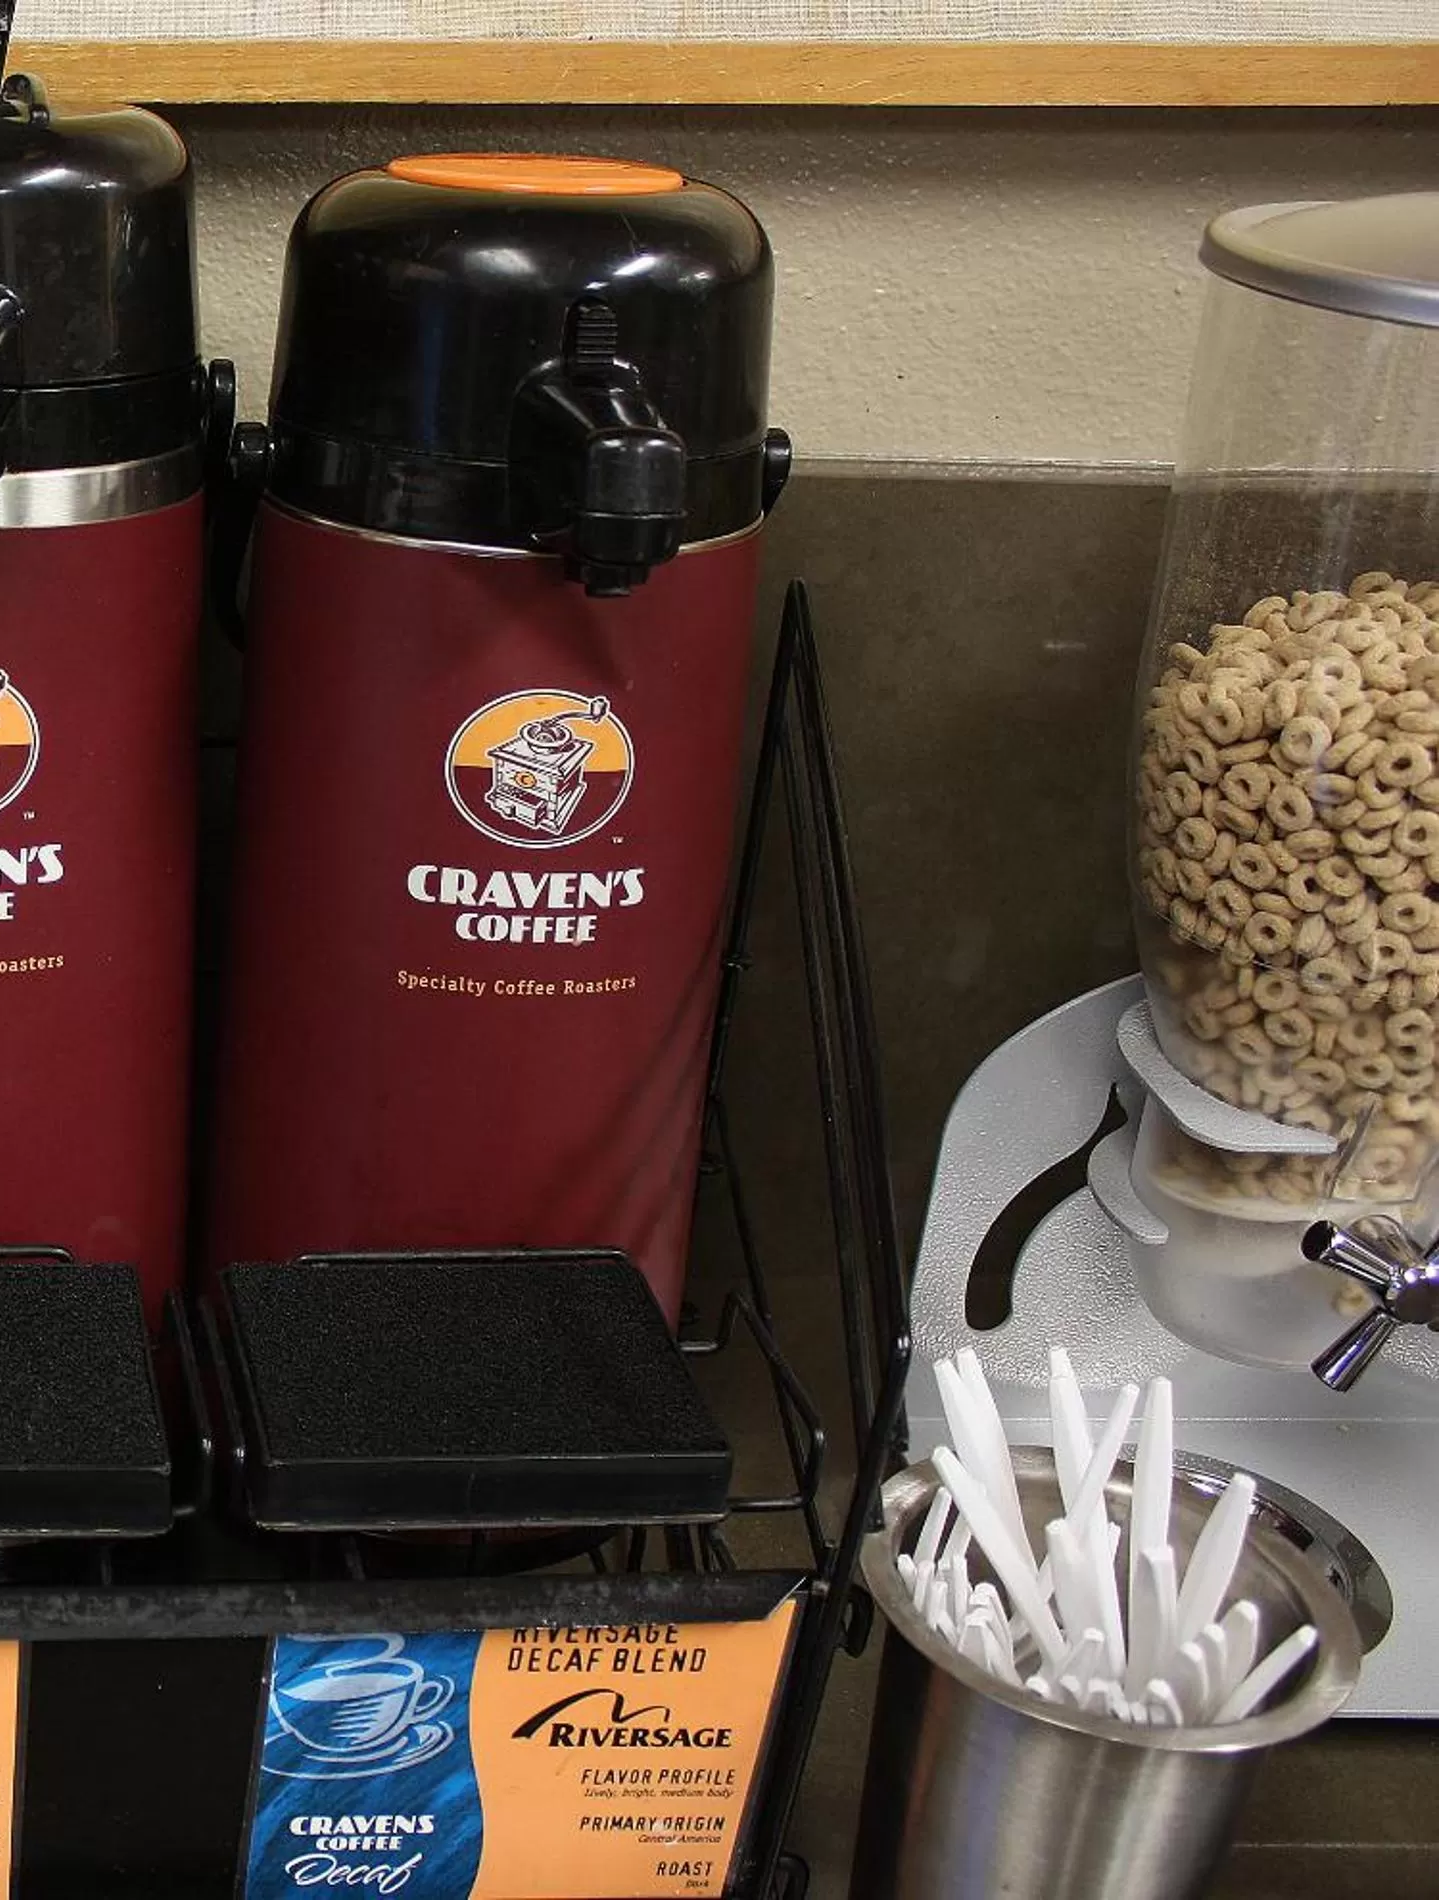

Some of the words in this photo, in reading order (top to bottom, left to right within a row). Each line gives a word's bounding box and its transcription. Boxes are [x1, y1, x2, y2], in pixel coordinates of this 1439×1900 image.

[407, 865, 645, 909] CRAVEN'S
[455, 913, 597, 944] COFFEE
[398, 970, 487, 997] Specialty
[494, 979, 556, 995] Coffee
[563, 974, 636, 994] Roasters
[508, 1648, 603, 1672] DECAF
[612, 1648, 707, 1673] BLEND
[548, 1722, 732, 1748] RIVERSAGE
[580, 1769, 652, 1785] FLAVOR
[658, 1769, 736, 1785] PROFILE
[660, 1788, 704, 1798] medium
[707, 1788, 734, 1799] body
[289, 1814, 435, 1836] CRAVENS
[580, 1816, 658, 1831] PRIMARY
[662, 1816, 726, 1831] ORIGIN
[315, 1835, 403, 1852] COFFEE
[284, 1852, 423, 1894] Decaf
[656, 1861, 715, 1877] ROAST
